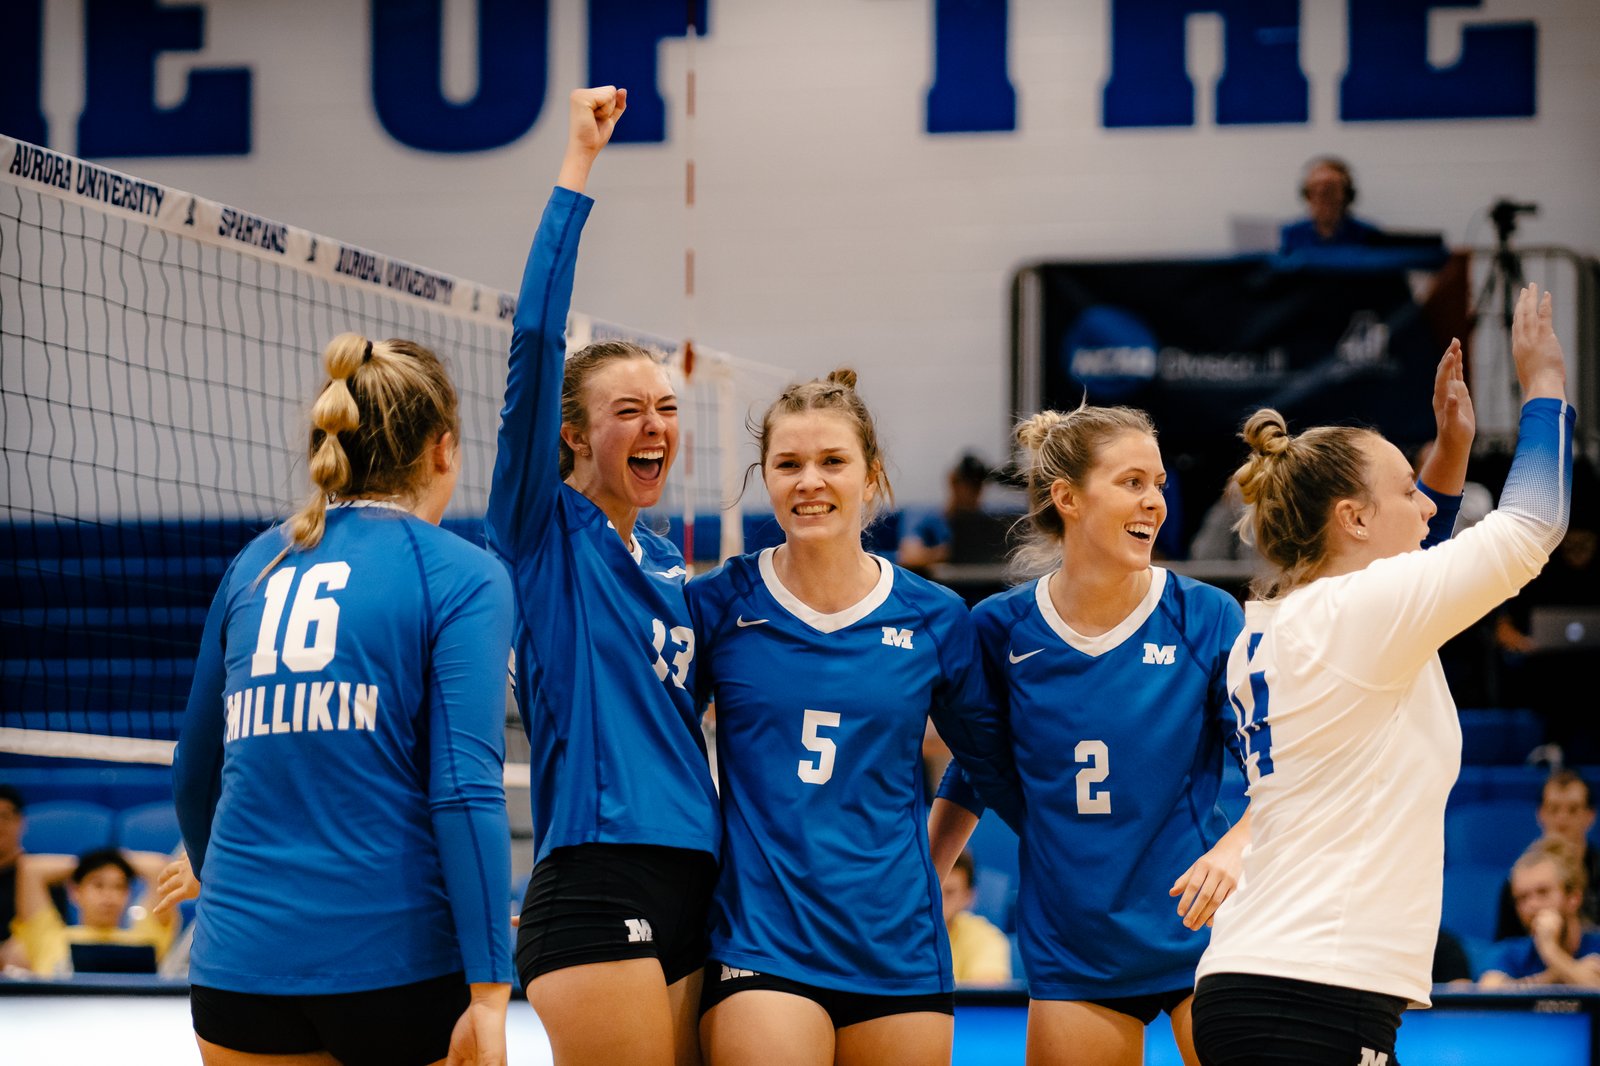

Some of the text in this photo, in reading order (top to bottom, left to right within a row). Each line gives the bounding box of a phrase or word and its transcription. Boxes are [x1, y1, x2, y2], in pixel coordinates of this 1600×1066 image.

[9, 142, 72, 192] AURORA
[76, 162, 165, 218] UNIVERSITY
[251, 560, 352, 678] 16
[881, 625, 915, 650] M
[1142, 642, 1177, 665] M
[226, 681, 379, 744] MILLIKIN
[797, 708, 841, 785] 5
[1074, 739, 1112, 815] 2
[624, 918, 653, 943] M
